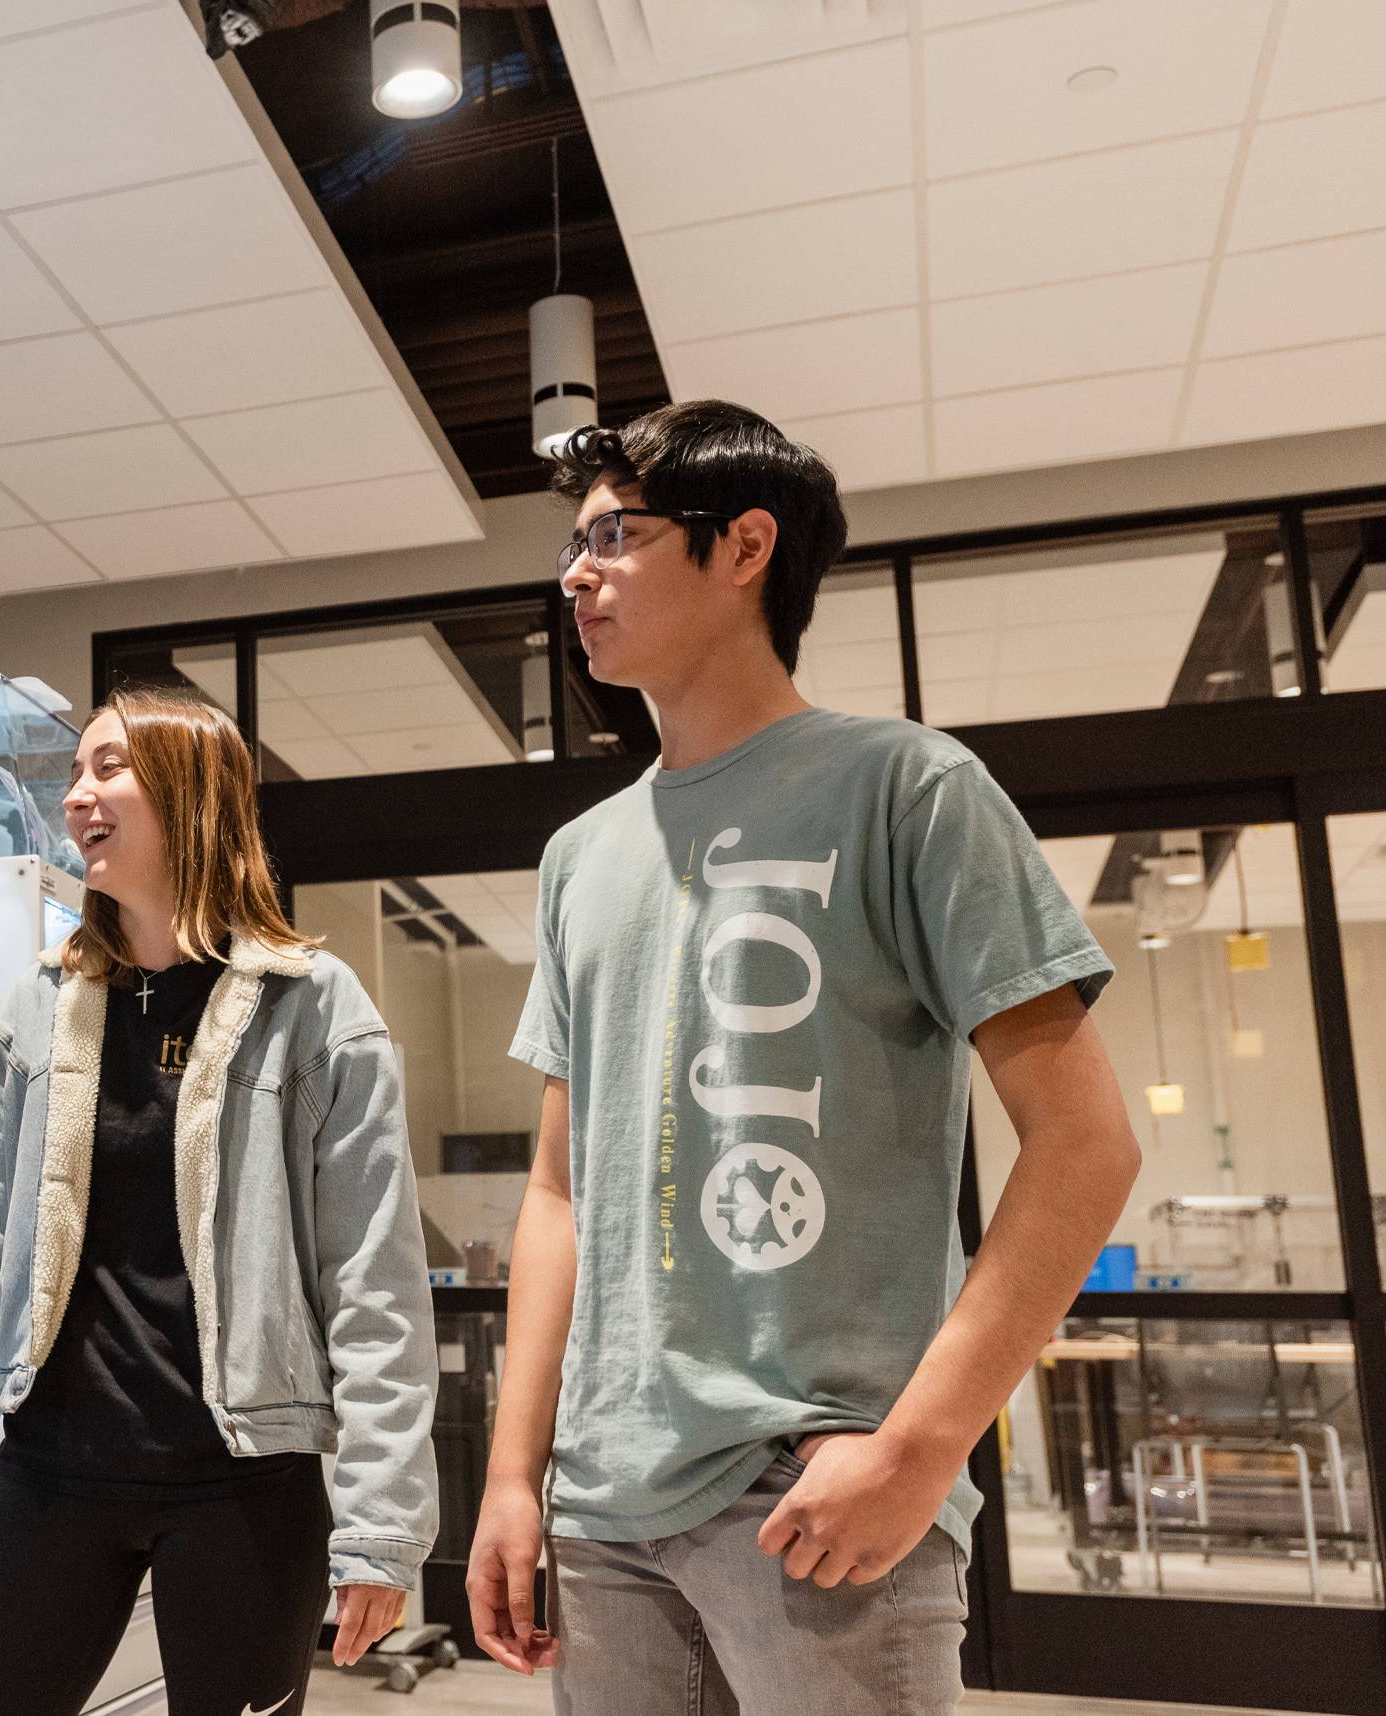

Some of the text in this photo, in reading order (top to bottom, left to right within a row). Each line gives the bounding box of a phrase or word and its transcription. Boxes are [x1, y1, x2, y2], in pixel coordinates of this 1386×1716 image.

[661, 1018, 679, 1106] Adventure
[661, 1113, 677, 1173] Golden
[660, 1183, 676, 1230] Wind
